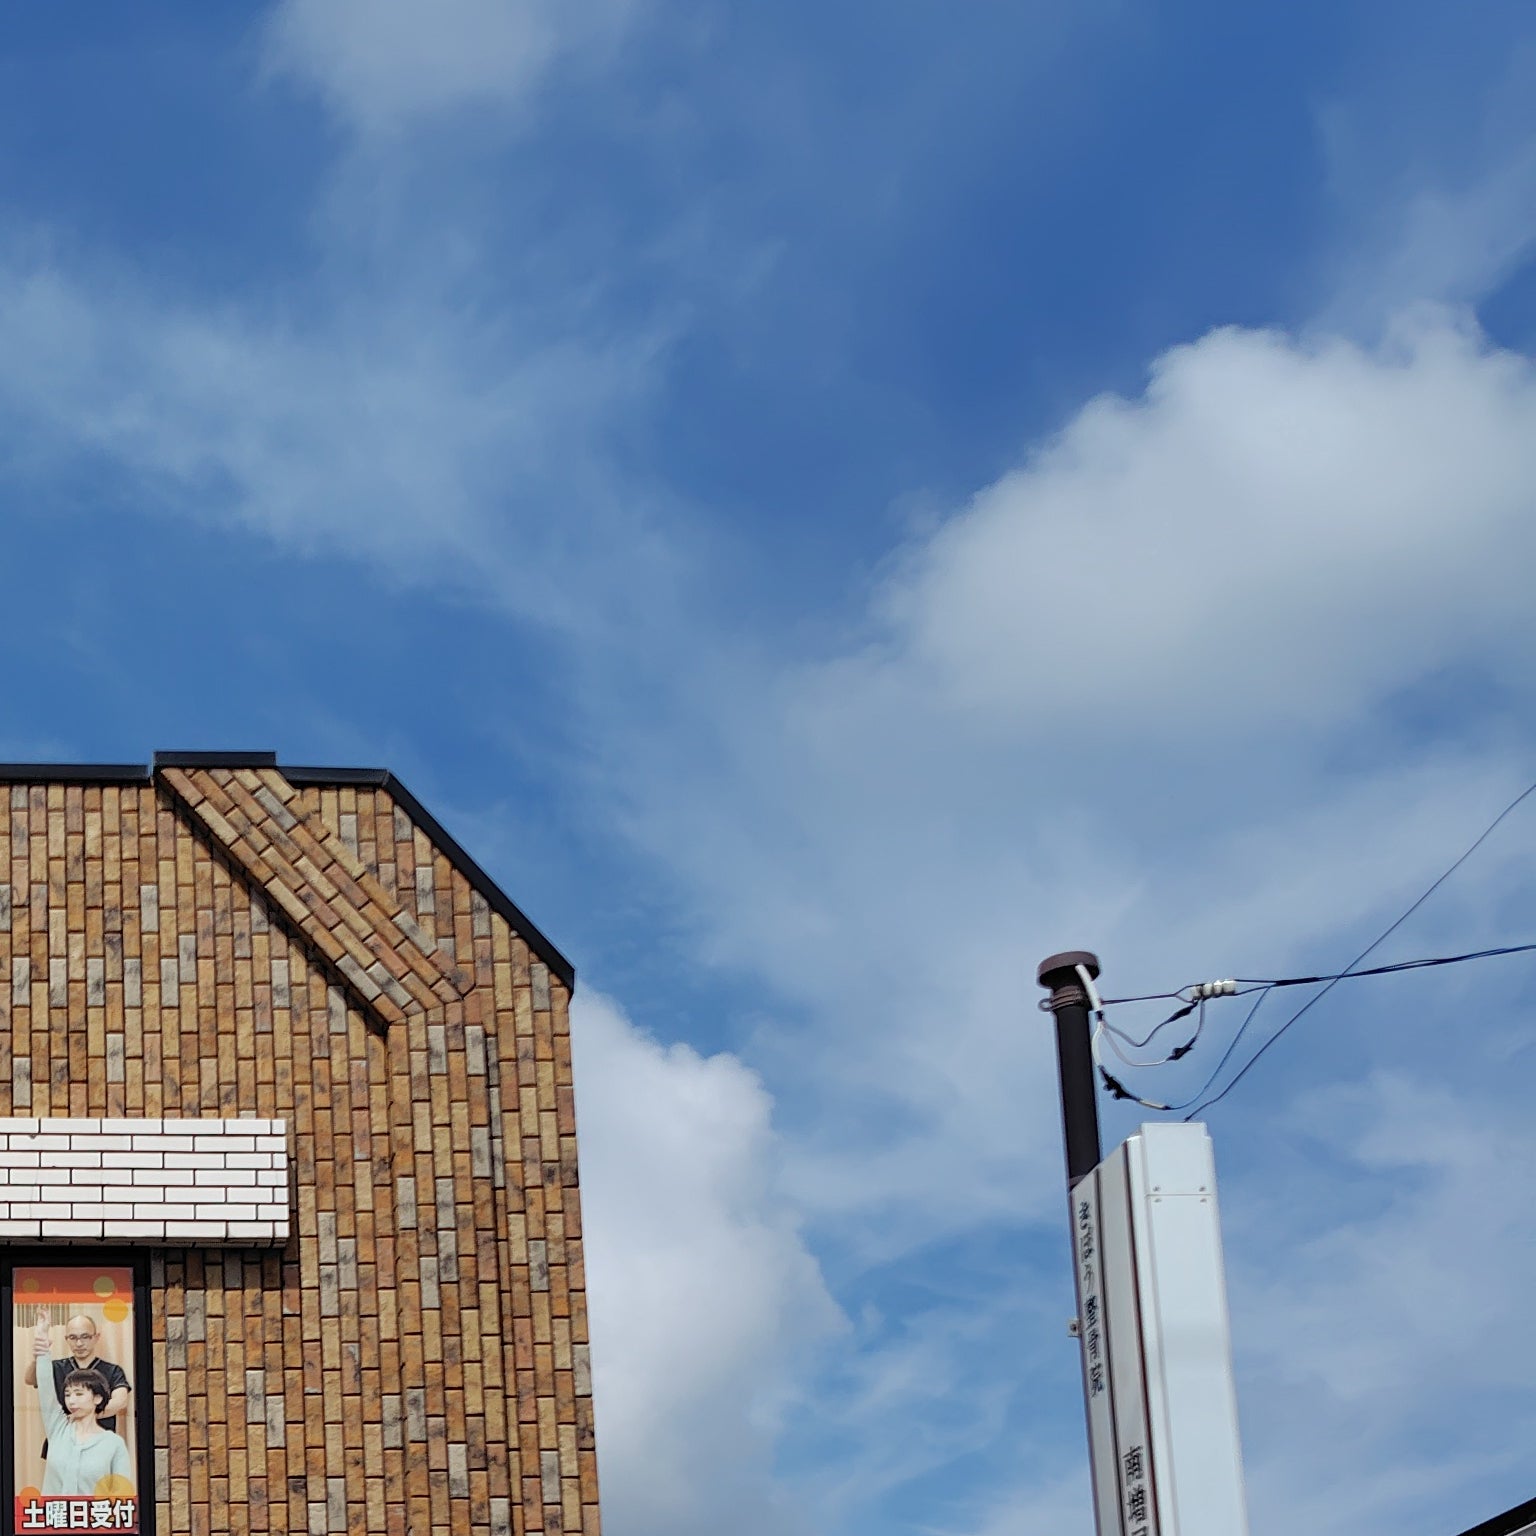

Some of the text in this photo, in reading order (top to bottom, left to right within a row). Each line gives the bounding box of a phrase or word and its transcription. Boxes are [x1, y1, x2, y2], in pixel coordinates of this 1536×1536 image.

[22, 1498, 135, 1530] 土曜日受付
